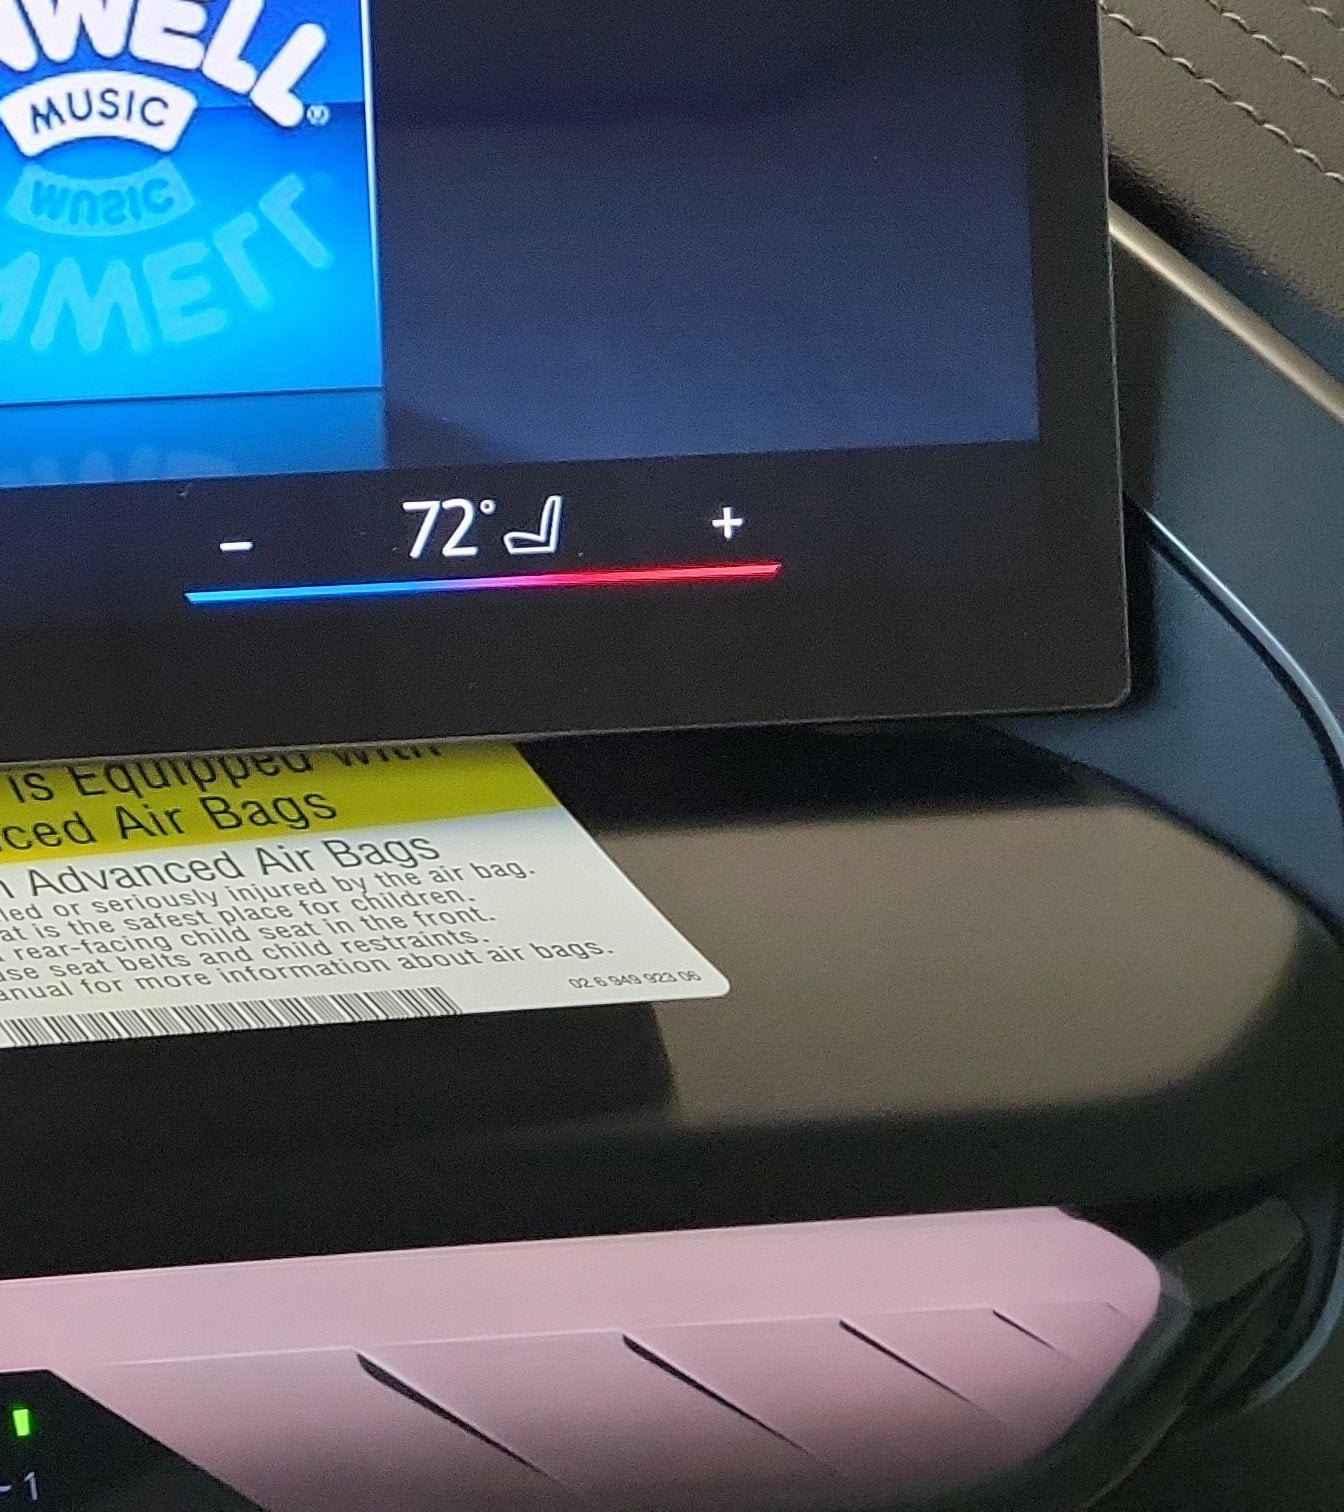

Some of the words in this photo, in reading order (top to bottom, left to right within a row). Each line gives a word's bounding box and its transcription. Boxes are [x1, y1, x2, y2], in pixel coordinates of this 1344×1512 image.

[29, 86, 171, 137] MUSIC
[9, 770, 55, 803] is
[114, 802, 187, 840] Air
[199, 788, 339, 832] Bags
[28, 851, 246, 897] Advanced
[255, 843, 316, 877] Air
[322, 836, 441, 870] Bags
[53, 902, 81, 918] or
[91, 888, 219, 913] seriously
[224, 879, 327, 905] injured
[332, 875, 367, 894] by
[375, 869, 422, 887] the
[428, 865, 465, 882] air
[470, 859, 536, 880] bag.
[13, 933, 173, 960] rear-facing
[180, 926, 250, 949] child
[257, 919, 319, 940] seat
[322, 917, 352, 934] in
[360, 912, 408, 931] the
[413, 906, 497, 927] front.
[31, 921, 61, 939] is
[69, 918, 115, 936] the
[126, 909, 212, 931] safest
[222, 902, 293, 928] place
[300, 897, 342, 919] for
[350, 886, 476, 913] children.
[49, 959, 112, 979] seat
[116, 950, 193, 974] belts
[199, 945, 254, 966] and
[261, 939, 333, 962] child
[340, 928, 490, 955] restraints.
[79, 976, 125, 996] for
[135, 972, 212, 992] more
[216, 956, 391, 985] information
[397, 949, 483, 971] about
[486, 944, 525, 964] air
[534, 937, 615, 960] bags.
[568, 977, 593, 989] 02
[23, 1470, 38, 1501] 1
